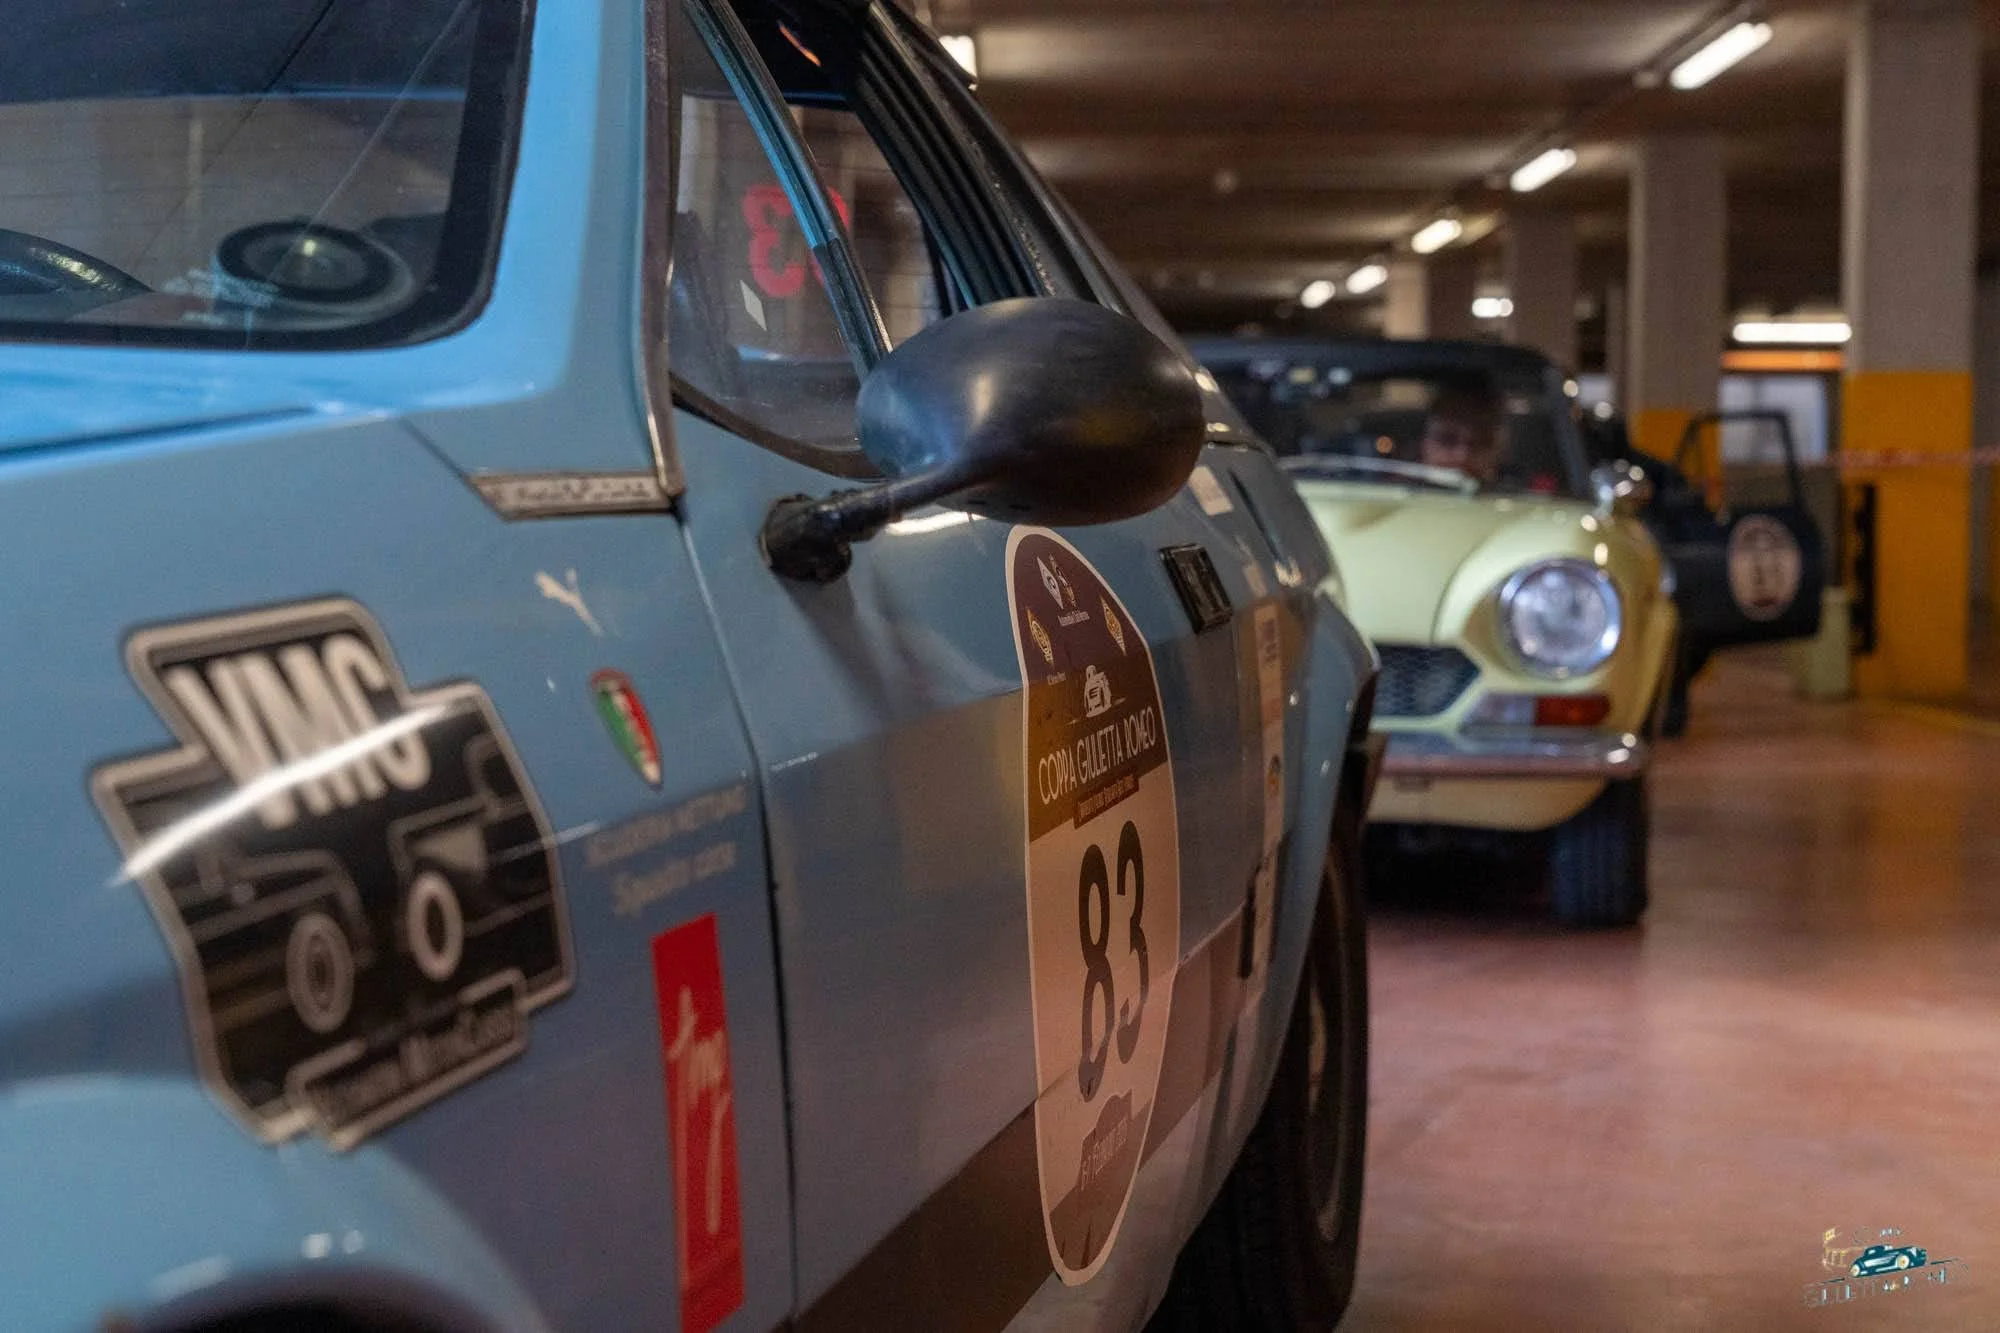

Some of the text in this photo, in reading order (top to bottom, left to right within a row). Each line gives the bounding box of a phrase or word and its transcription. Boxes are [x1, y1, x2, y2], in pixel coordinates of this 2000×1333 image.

[166, 634, 431, 830] VMC
[1039, 746, 1078, 805] COPPA
[1077, 723, 1124, 784] GIULIETTA
[1124, 705, 1156, 760] ROMEO
[1078, 820, 1149, 1103] 83
